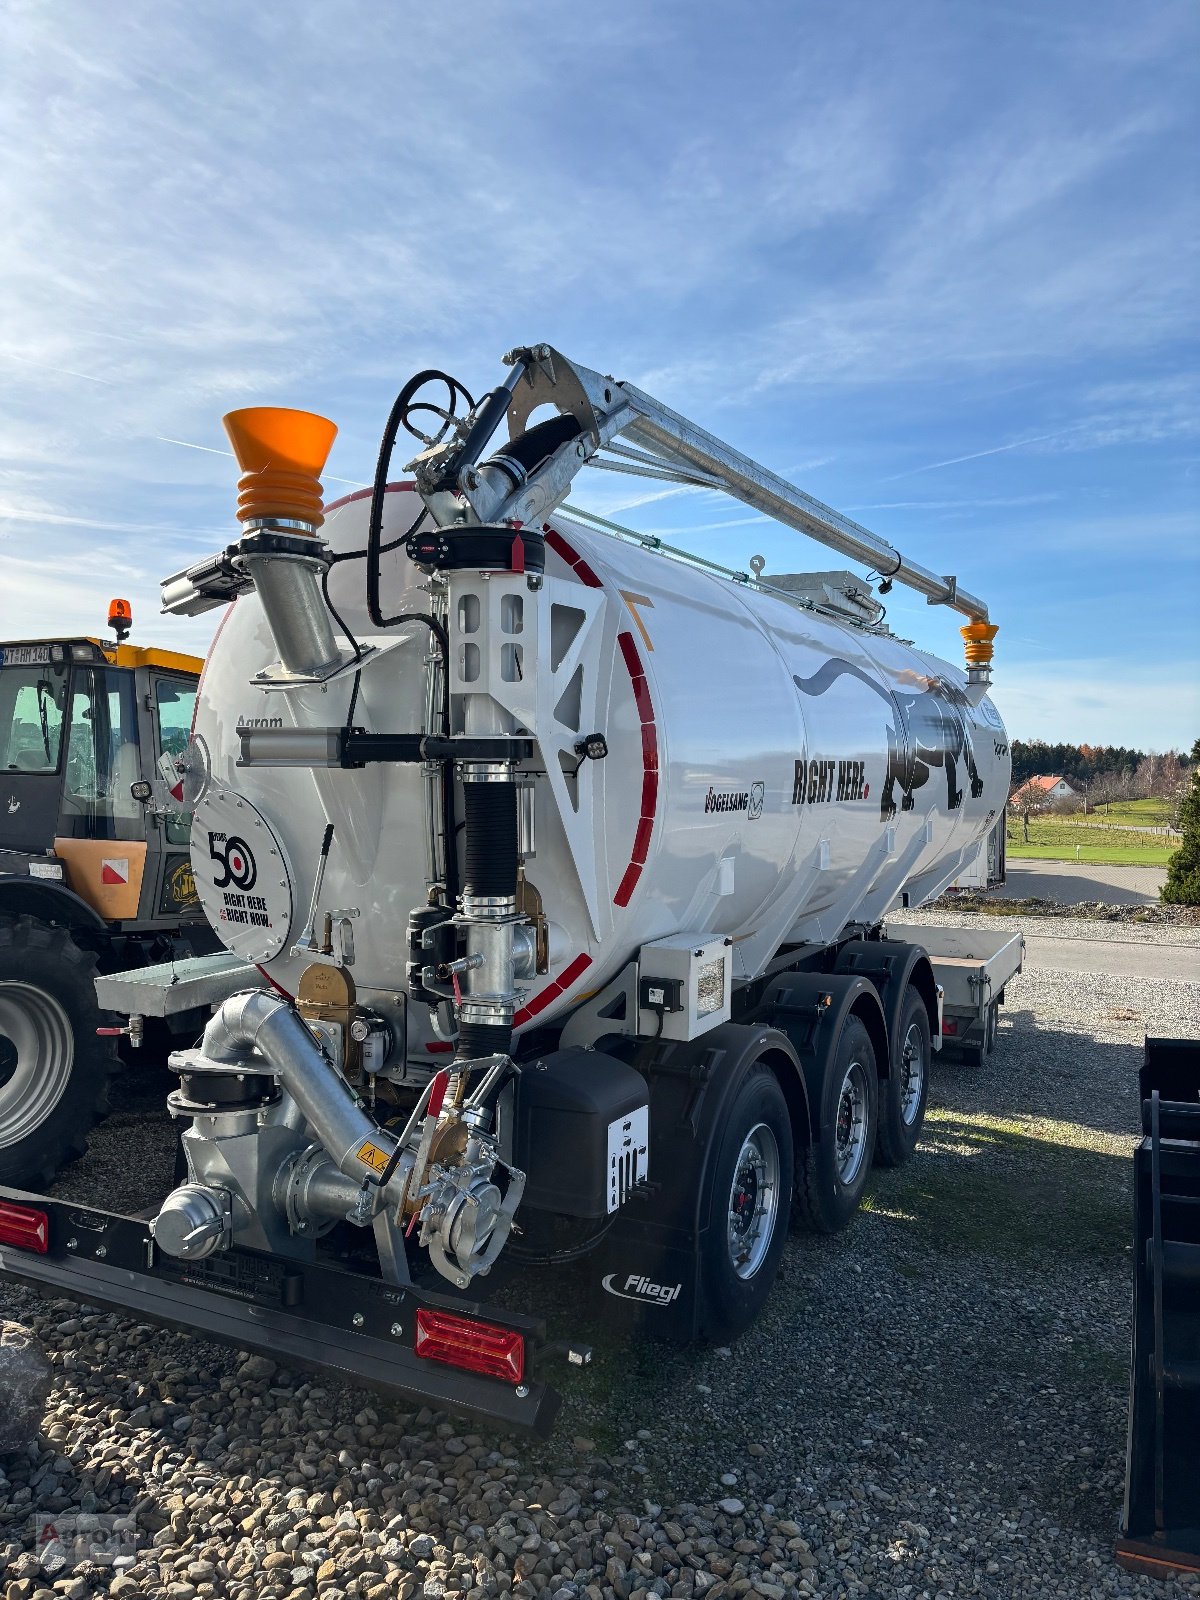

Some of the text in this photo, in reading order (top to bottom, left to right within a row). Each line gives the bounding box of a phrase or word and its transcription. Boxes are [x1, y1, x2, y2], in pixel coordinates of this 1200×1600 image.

[33, 647, 49, 661] 140
[792, 760, 835, 804] RIGHT
[223, 893, 267, 911] RIGHT HERE
[226, 908, 248, 924] RIGHT
[624, 1275, 682, 1303] Fliegl
